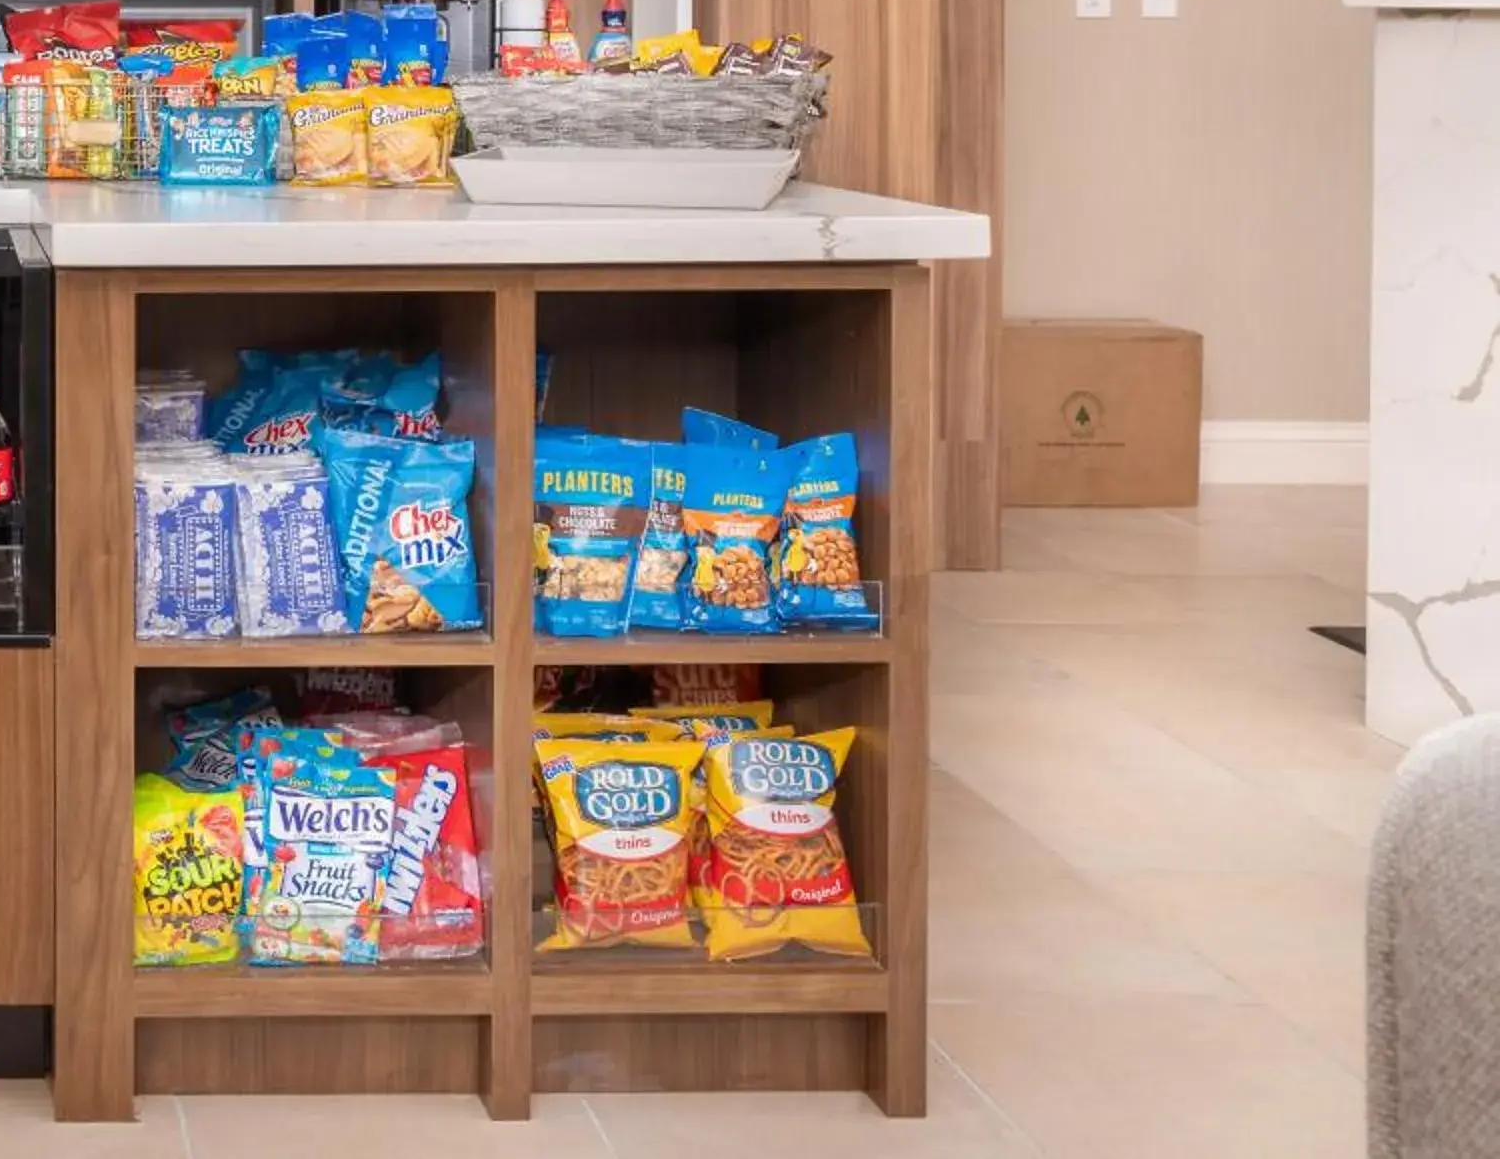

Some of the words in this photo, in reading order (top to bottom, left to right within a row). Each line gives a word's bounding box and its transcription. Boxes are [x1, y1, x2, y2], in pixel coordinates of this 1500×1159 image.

[188, 139, 254, 156] TREATS
[245, 410, 317, 445] Chex
[542, 469, 634, 498] PLANTERS
[712, 492, 765, 509] PLANTERS
[345, 458, 393, 597] TRADITIONAL
[558, 517, 617, 530] CHOCOLATE
[402, 523, 467, 568] mix
[749, 742, 820, 766] ROLD
[593, 765, 666, 790] ROLD
[741, 765, 829, 793] GOLD
[276, 799, 389, 834] Welch's
[587, 791, 671, 820] GOLD
[771, 810, 812, 825] thins
[615, 835, 652, 850] thins
[148, 854, 236, 896] SOUR
[306, 858, 358, 880] Fruit
[146, 881, 242, 918] PATCH
[286, 873, 366, 903] Snacks
[790, 878, 844, 903] Original
